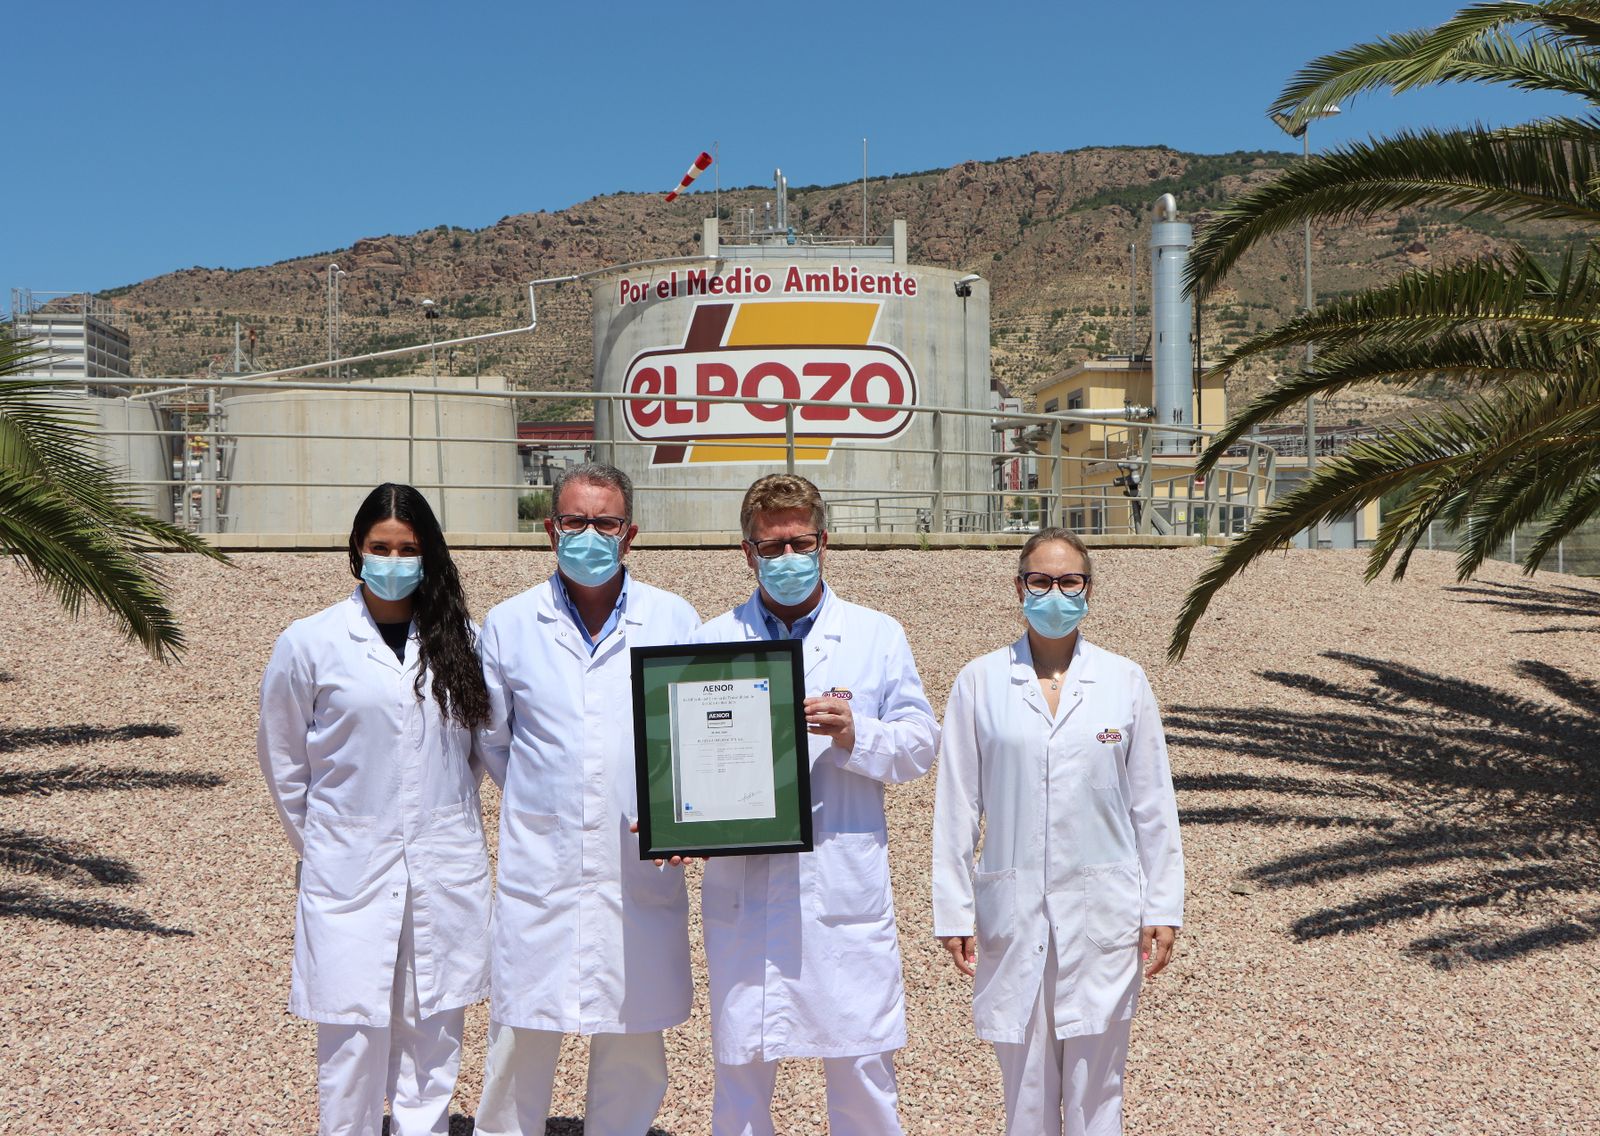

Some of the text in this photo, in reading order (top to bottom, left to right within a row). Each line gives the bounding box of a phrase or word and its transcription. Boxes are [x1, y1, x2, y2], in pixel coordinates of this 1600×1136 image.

[619, 265, 918, 304] Por el Medio Ambiente
[703, 684, 734, 692] AENOR
